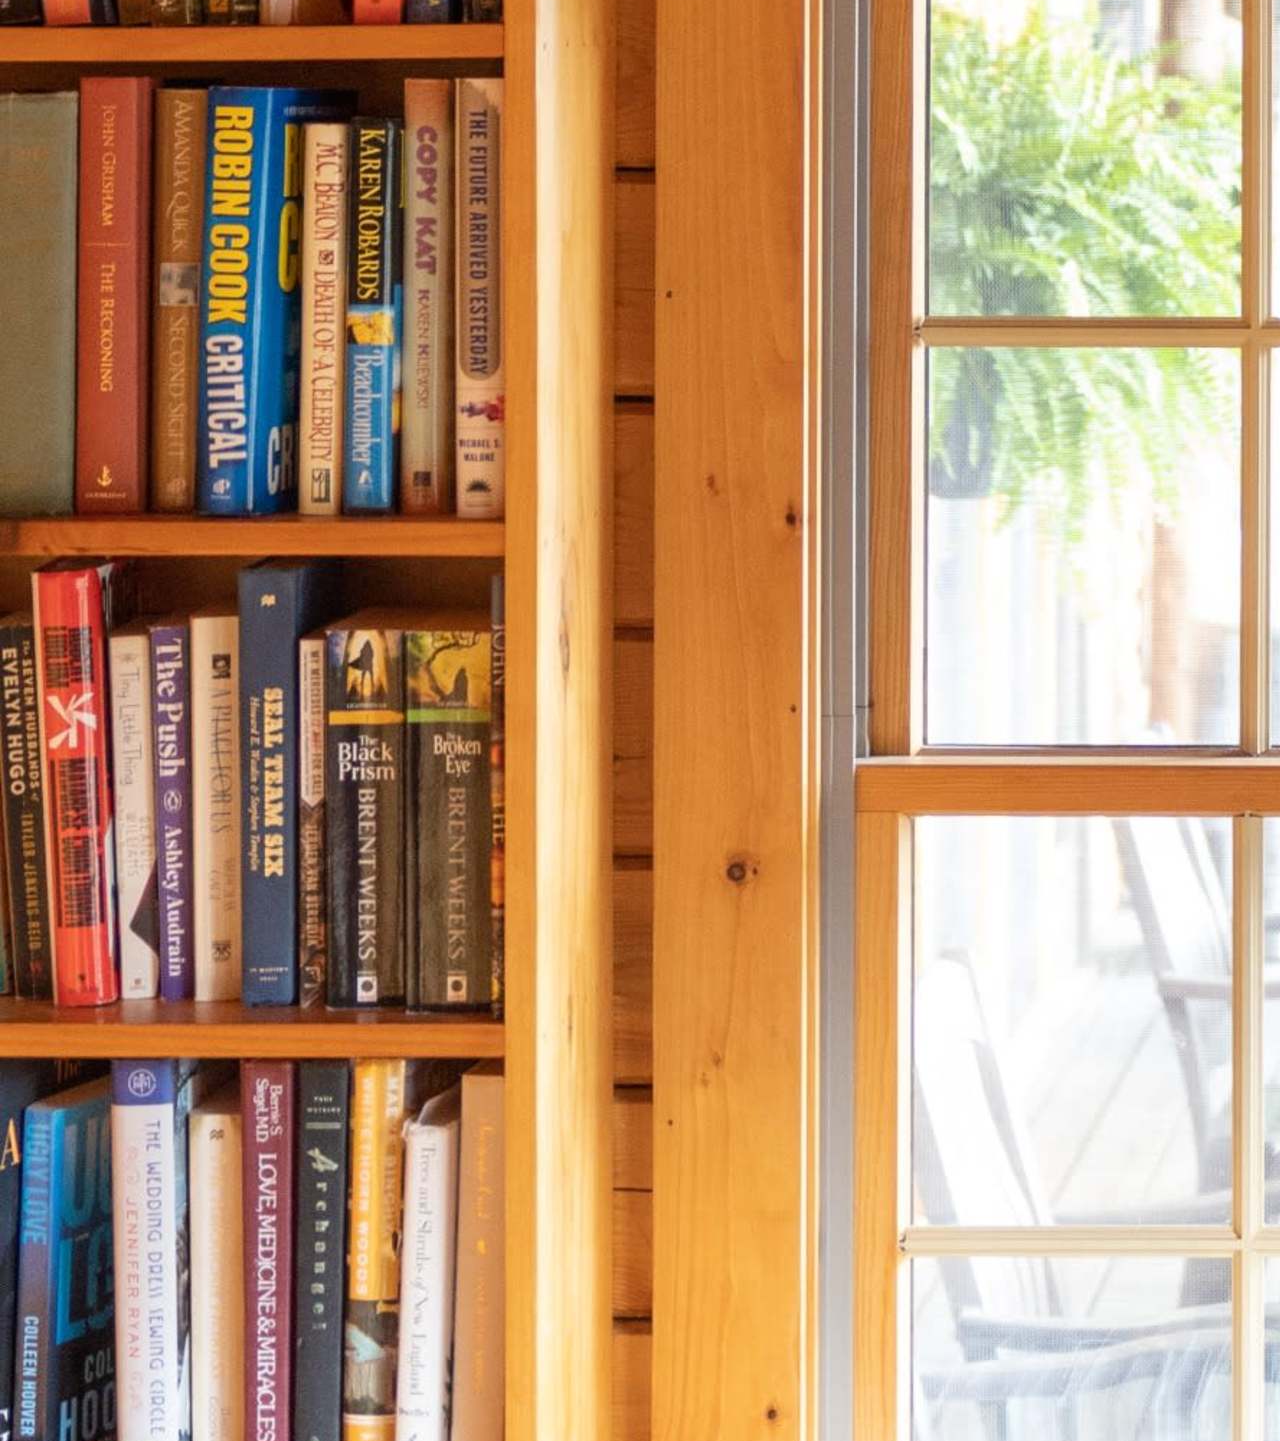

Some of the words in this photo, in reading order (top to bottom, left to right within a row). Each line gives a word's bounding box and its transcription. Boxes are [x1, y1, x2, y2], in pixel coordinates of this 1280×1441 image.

[212, 106, 254, 216] ROBIN
[359, 128, 385, 197] KAREN
[208, 224, 249, 325] COOK
[357, 201, 383, 300] ROBARDS
[206, 335, 247, 468] CRITICAL
[157, 637, 184, 699] The
[159, 704, 187, 779] Push
[262, 687, 283, 747] SEAL
[338, 742, 393, 762] Black
[262, 755, 283, 828] TEAM
[338, 763, 395, 781] Prism
[263, 833, 283, 877] SIX
[357, 788, 377, 869] BRENT
[357, 874, 377, 960] WEEKS
